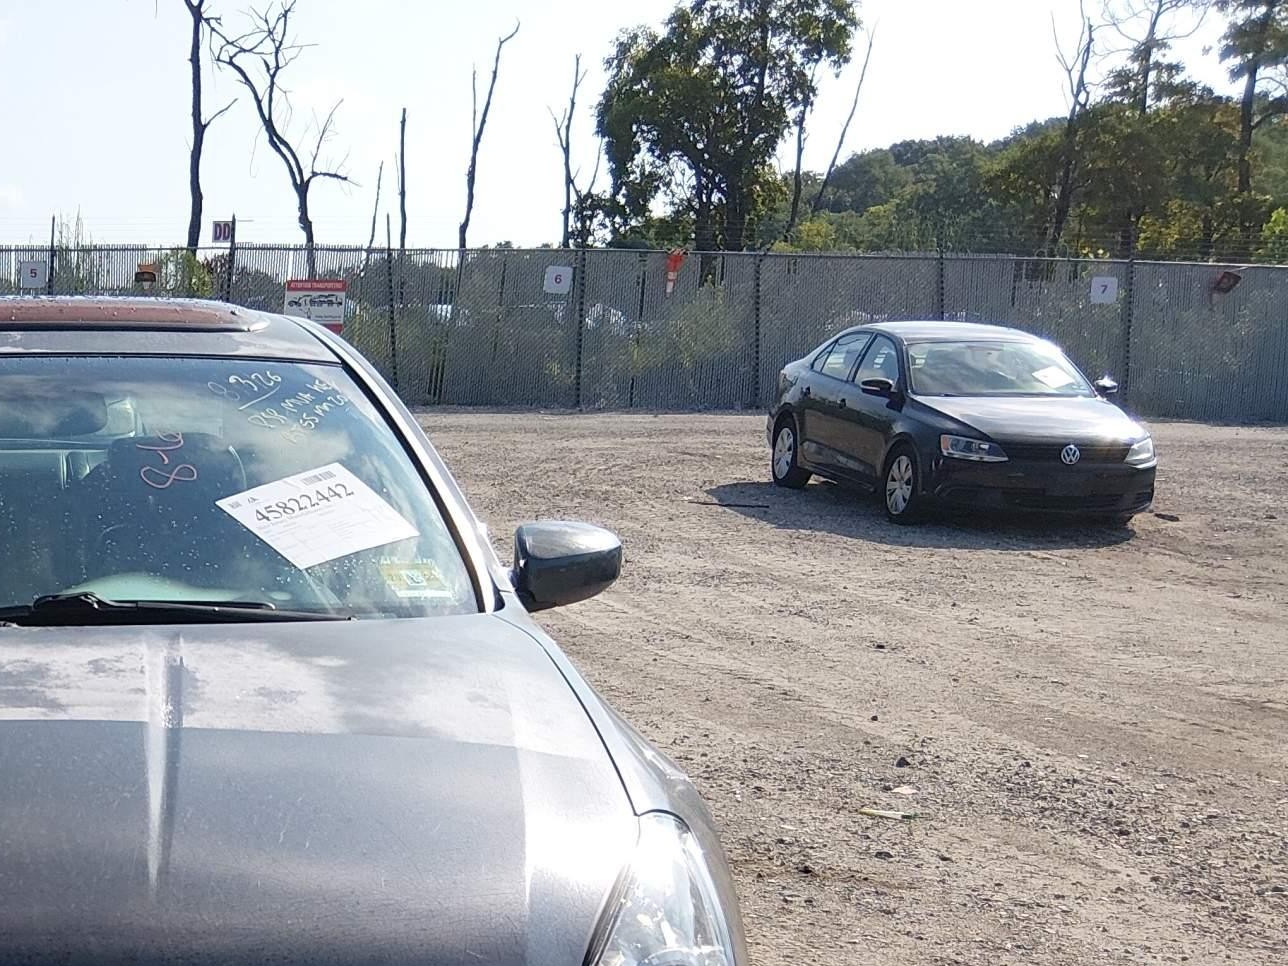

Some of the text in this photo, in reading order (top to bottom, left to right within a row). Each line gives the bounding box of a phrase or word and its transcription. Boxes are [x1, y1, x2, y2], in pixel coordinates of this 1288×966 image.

[30, 269, 37, 278] 5
[554, 275, 562, 284] 6
[1101, 285, 1108, 294] 7
[255, 483, 355, 522] 45822442
